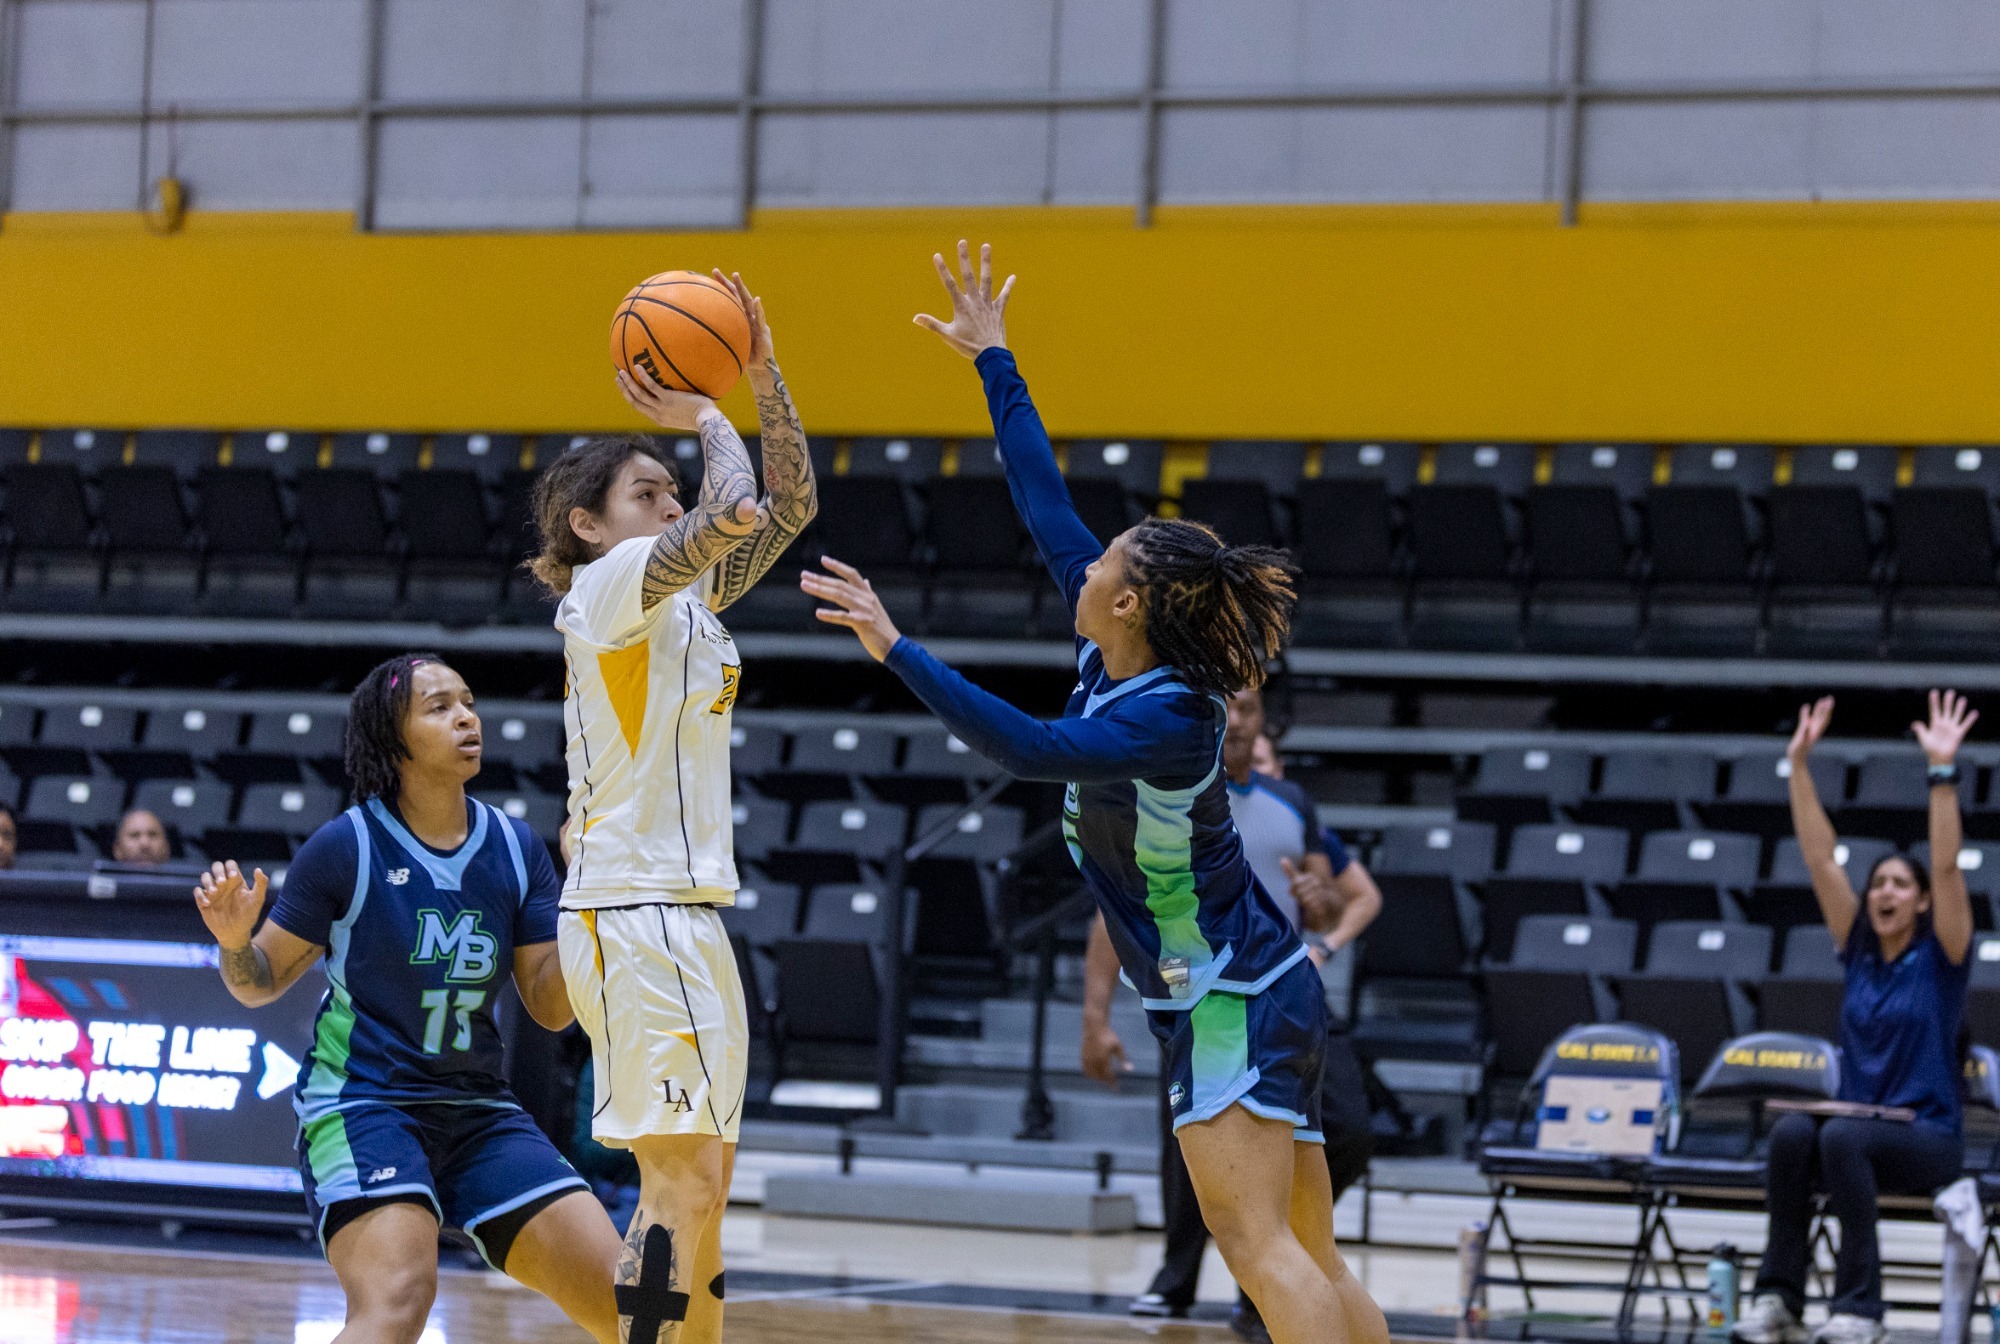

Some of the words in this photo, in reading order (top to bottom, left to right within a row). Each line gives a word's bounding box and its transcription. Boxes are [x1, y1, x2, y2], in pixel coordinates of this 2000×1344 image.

[409, 908, 499, 984] MB
[0, 1017, 79, 1063] SKIP
[87, 1021, 166, 1069] THE
[169, 1025, 257, 1073] LINE
[660, 1079, 695, 1113] LA
